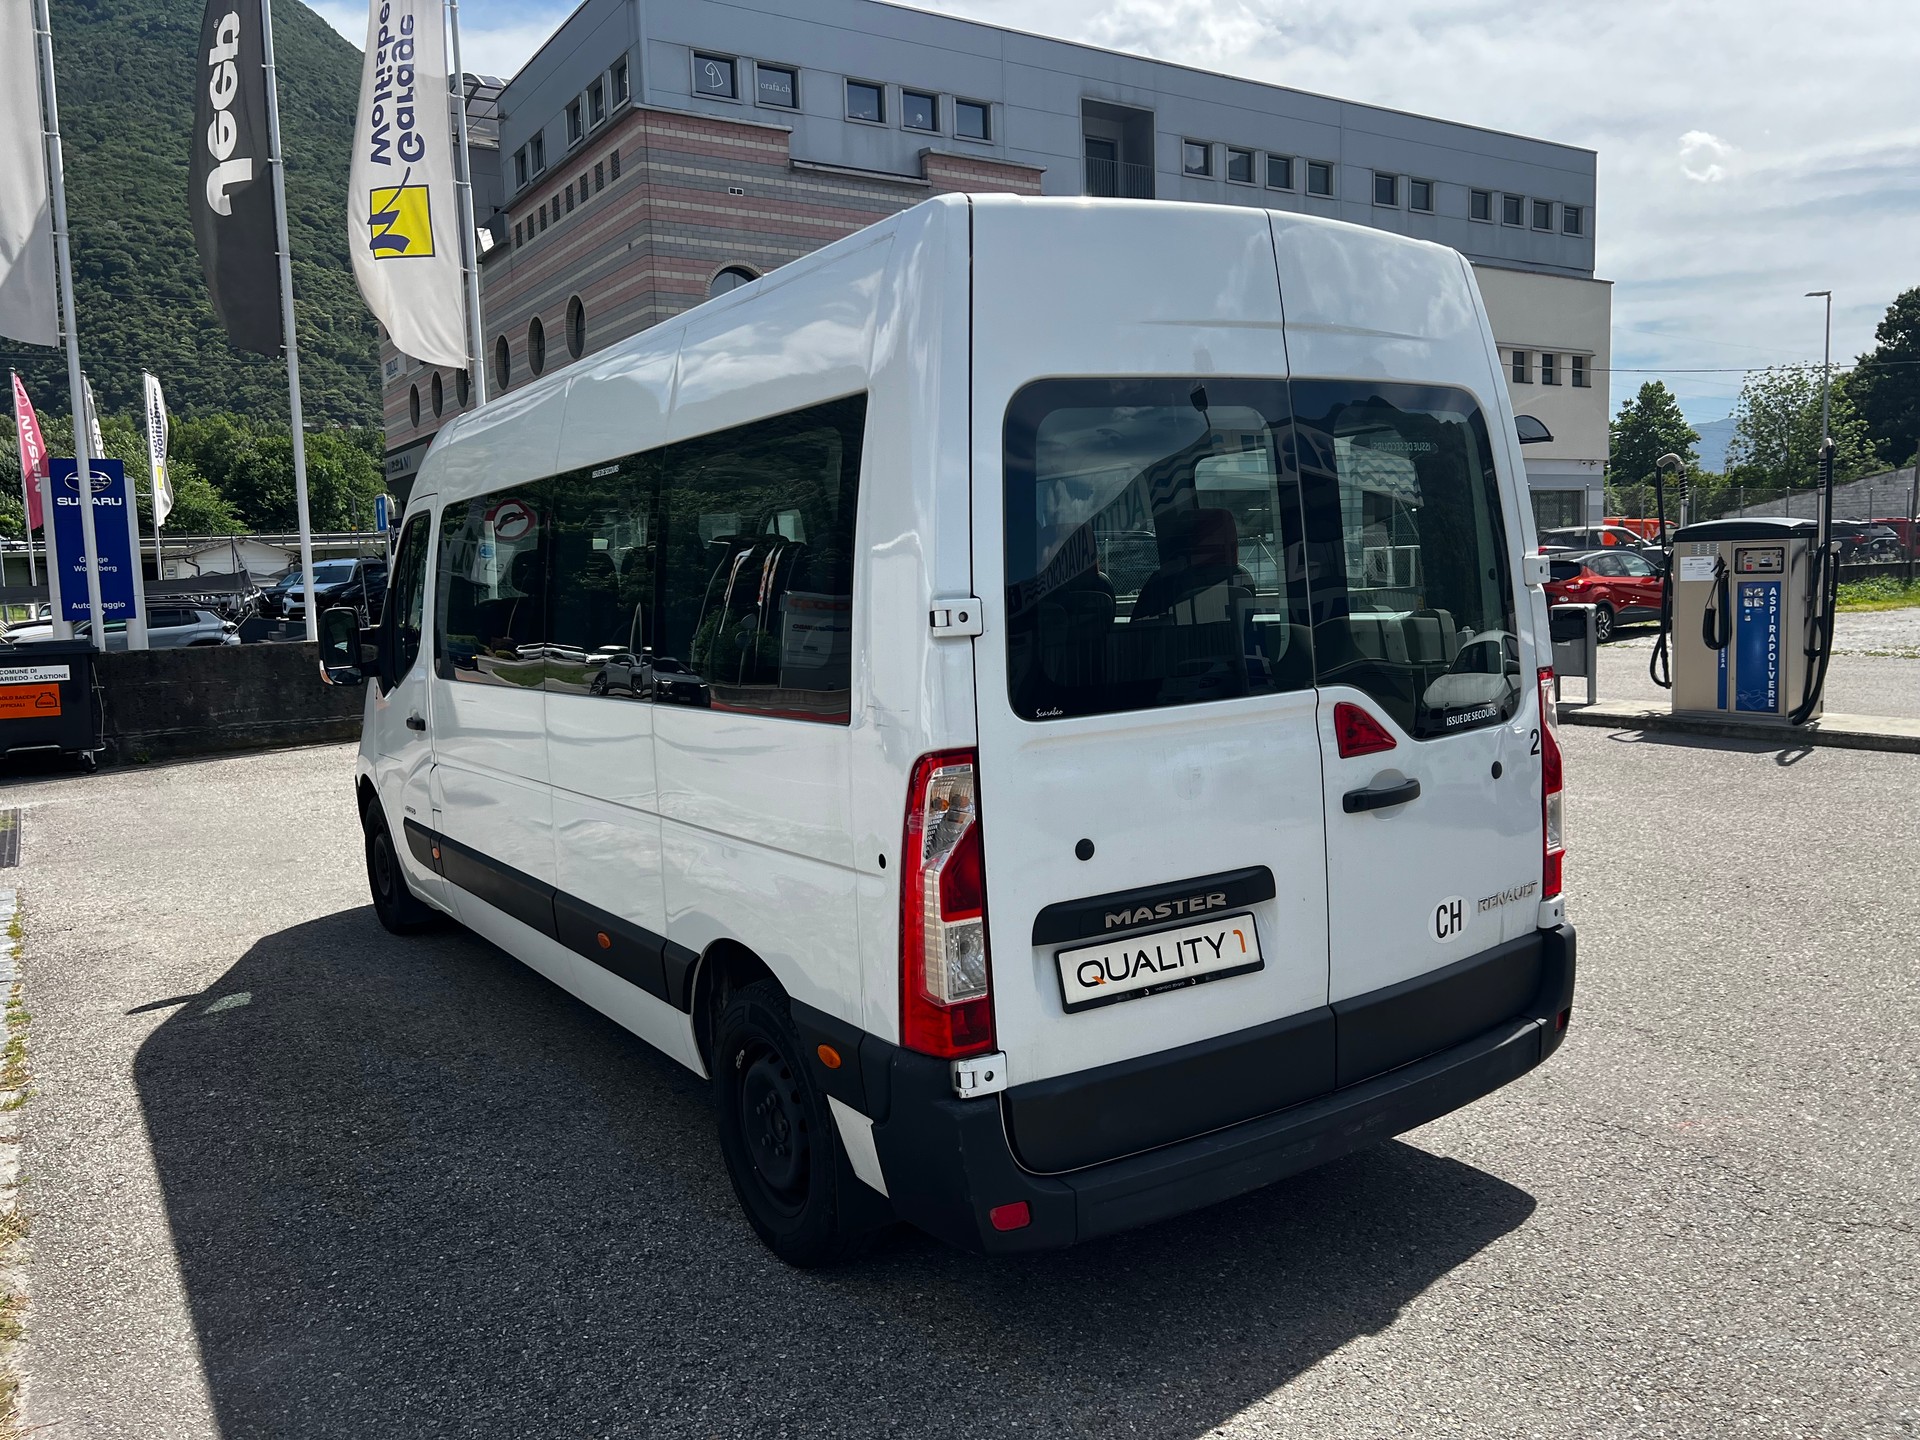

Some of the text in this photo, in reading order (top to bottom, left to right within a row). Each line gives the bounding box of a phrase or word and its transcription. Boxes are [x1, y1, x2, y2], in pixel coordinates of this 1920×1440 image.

[760, 82, 791, 93] orafa.ch
[57, 497, 122, 506] SUARU
[73, 565, 118, 573] Woberg
[1767, 586, 1778, 708] ASPIRAPOLVERE
[1446, 706, 1497, 727] ISSUE DE SECOURS
[1529, 728, 1540, 756] 2
[1104, 892, 1227, 929] MASTER
[1477, 880, 1538, 914] RENAULT
[1436, 899, 1462, 939] CH
[1076, 931, 1226, 988] QUALITY
